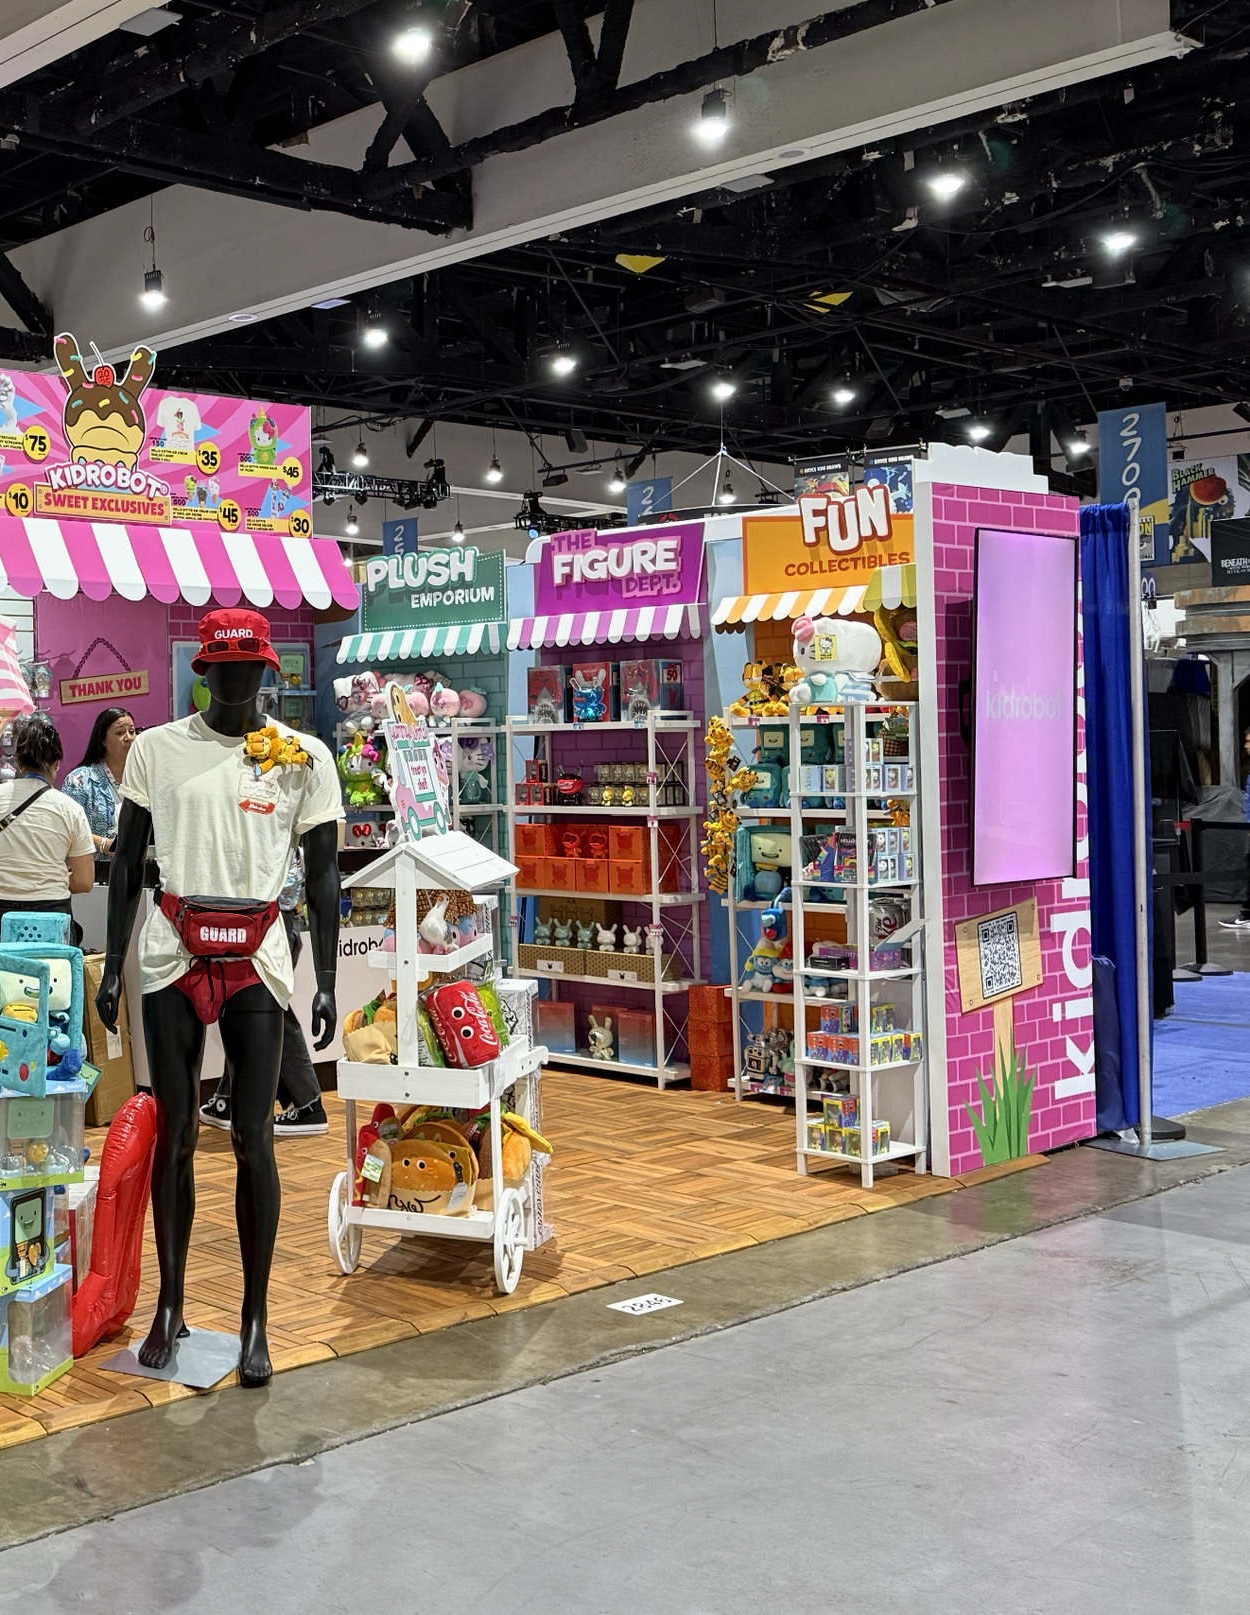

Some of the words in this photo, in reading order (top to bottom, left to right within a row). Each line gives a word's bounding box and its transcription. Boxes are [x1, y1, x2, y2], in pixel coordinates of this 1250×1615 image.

[25, 434, 47, 452] $75
[198, 449, 218, 467] $35
[282, 465, 300, 479] $45
[1171, 462, 1204, 482] BLACK
[1171, 467, 1215, 495] HAMMER
[8, 491, 29, 509] $10
[44, 492, 90, 511] SWEET
[91, 497, 165, 516] EXCLUSIVES
[219, 507, 239, 524] $45
[291, 515, 310, 534] $30
[799, 486, 891, 553] FUN
[553, 531, 593, 552] THE
[366, 548, 477, 593] PLUSH
[553, 540, 679, 585] FIGURE
[784, 551, 911, 577] COLLECTIBLES
[625, 573, 679, 593] DEPT.
[410, 586, 495, 609] EMPORIUM
[214, 627, 253, 640] GUARD
[69, 680, 114, 699] THANK
[115, 676, 142, 694] YOU
[199, 926, 248, 945] GUARD
[338, 936, 383, 958] idrob
